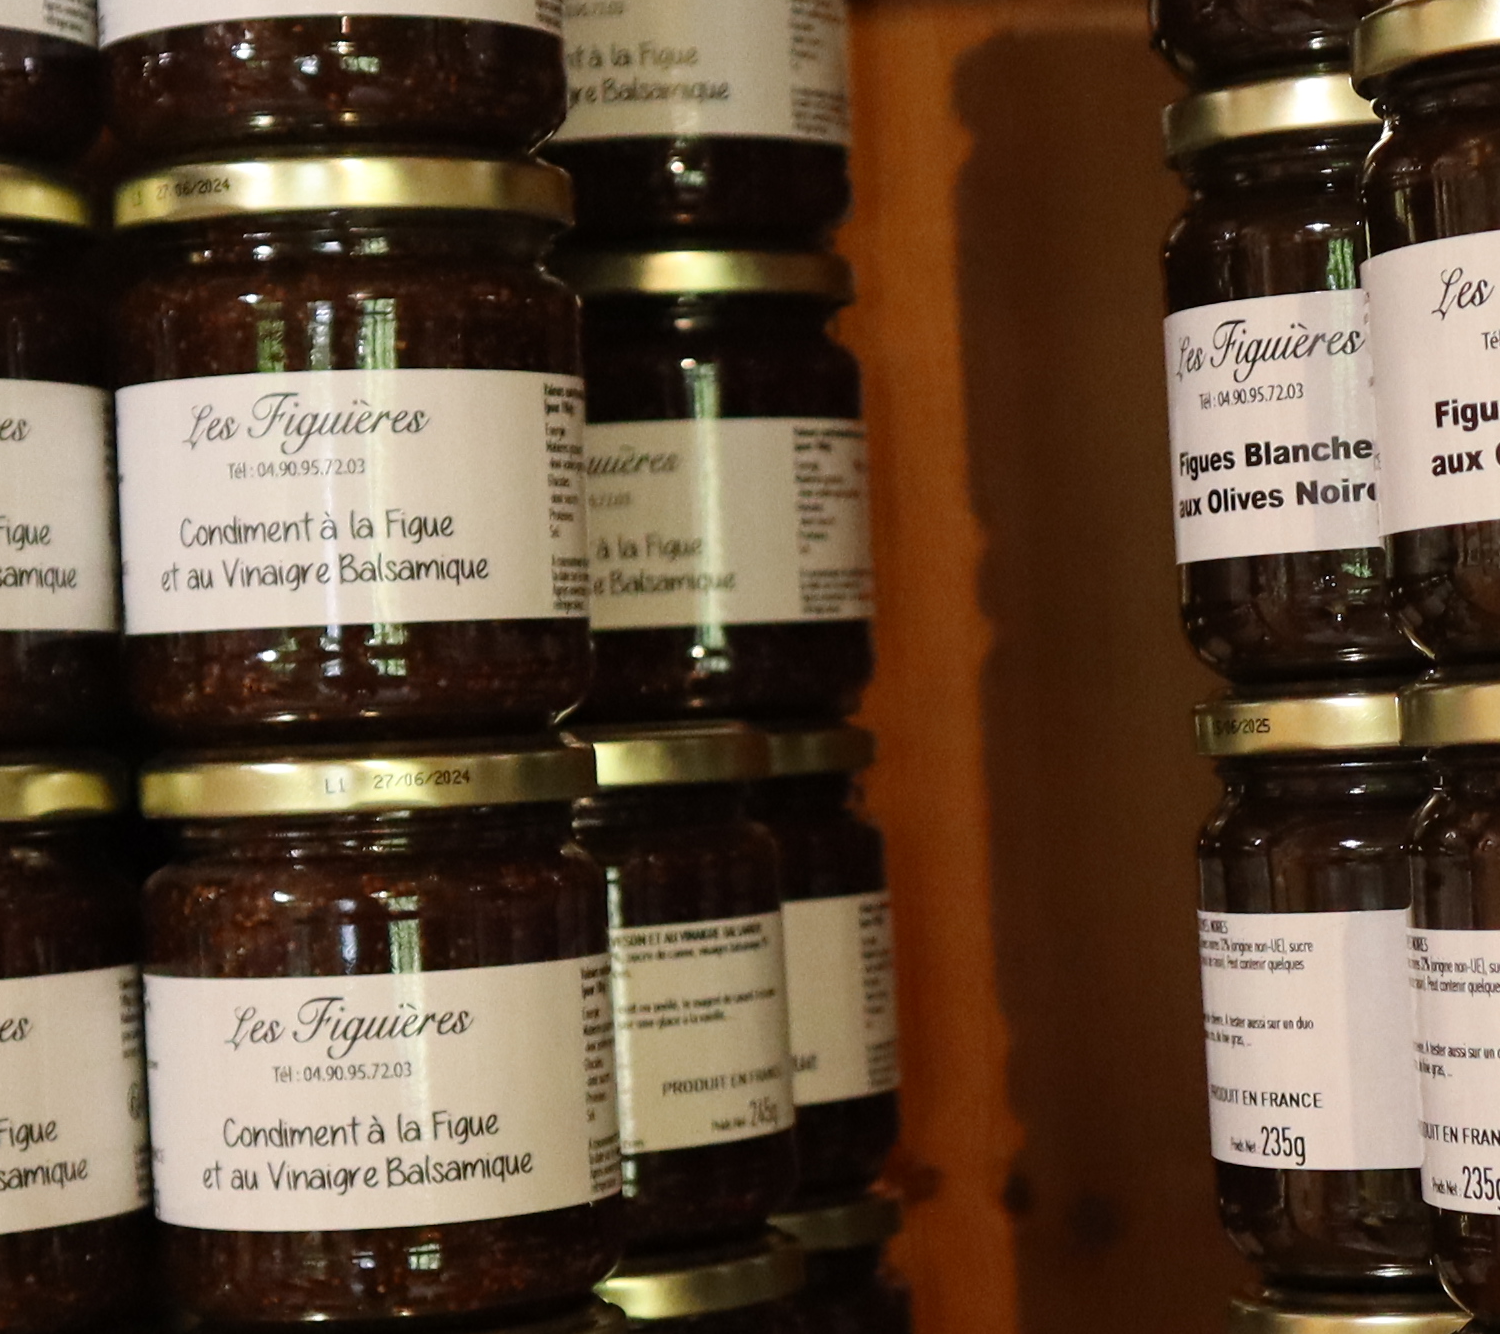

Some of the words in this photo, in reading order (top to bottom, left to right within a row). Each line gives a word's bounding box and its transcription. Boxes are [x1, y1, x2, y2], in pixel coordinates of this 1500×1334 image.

[1431, 266, 1494, 320] Les
[1430, 448, 1483, 477] aux
[373, 769, 470, 790] 27/06/2024
[224, 1005, 285, 1051] Les
[292, 996, 474, 1059] Figuières
[222, 1116, 367, 1148] Condiment
[368, 1115, 385, 1143] à
[397, 1113, 421, 1142] la
[432, 1111, 499, 1146] Figue
[1441, 1125, 1459, 1144] EN
[202, 1163, 222, 1190] et
[230, 1168, 259, 1191] au
[267, 1160, 378, 1194] Vinaigre
[385, 1150, 533, 1189] Balsamique
